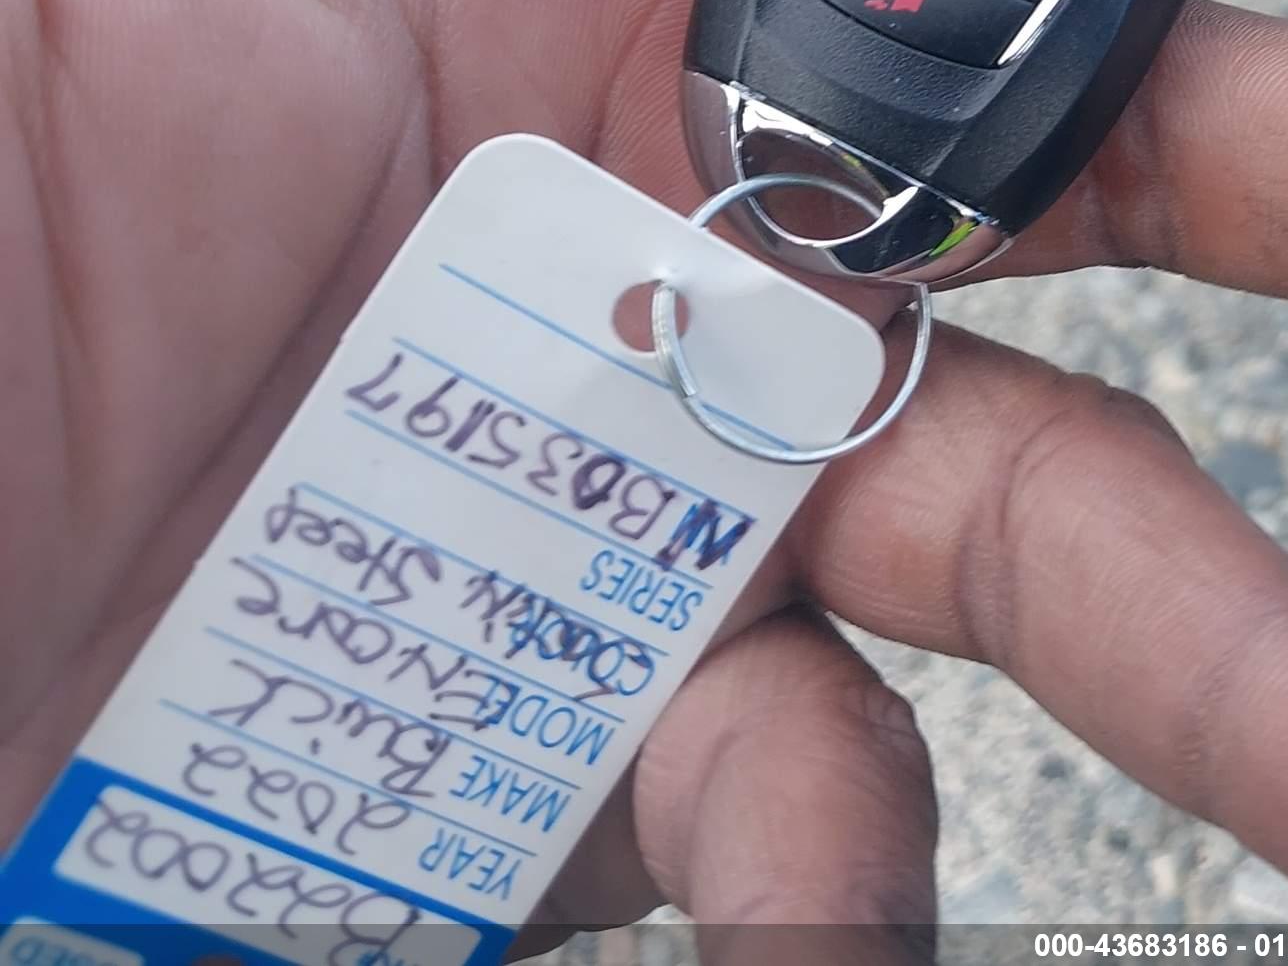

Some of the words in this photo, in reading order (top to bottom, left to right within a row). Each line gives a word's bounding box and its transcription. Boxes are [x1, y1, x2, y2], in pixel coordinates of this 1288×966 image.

[578, 548, 704, 632] SERIES
[468, 674, 612, 766] MODEL
[181, 742, 411, 856] 2022
[447, 754, 571, 833] MAKE
[84, 793, 426, 964] B22002
[417, 827, 522, 900] YEAR
